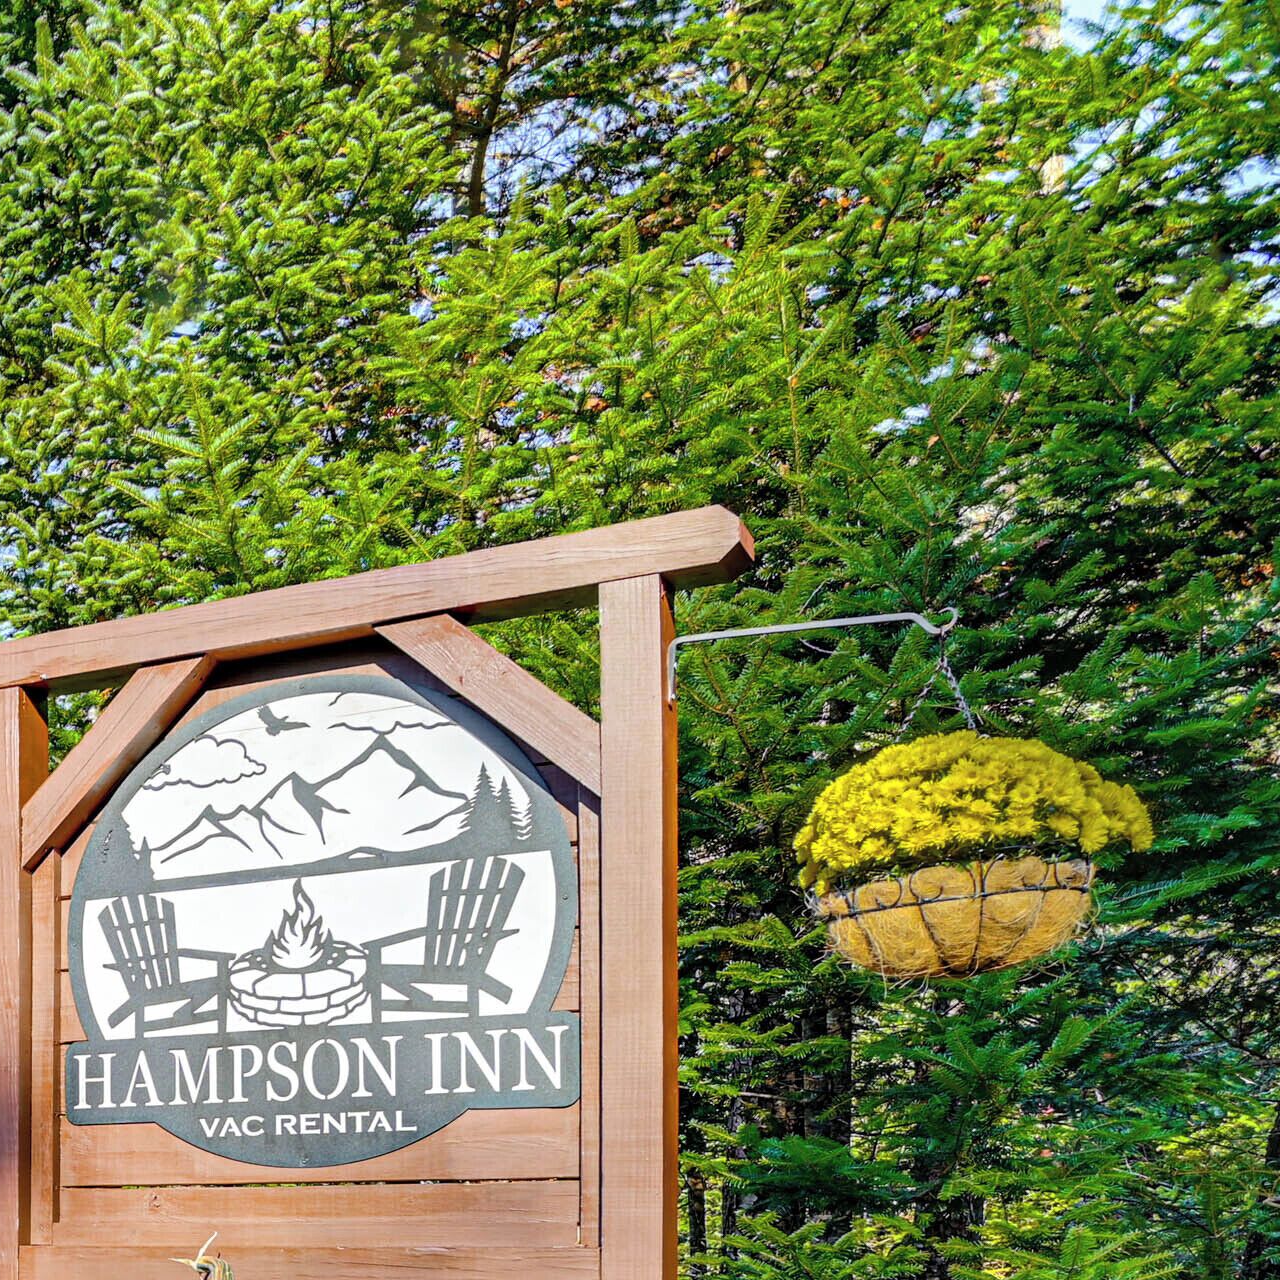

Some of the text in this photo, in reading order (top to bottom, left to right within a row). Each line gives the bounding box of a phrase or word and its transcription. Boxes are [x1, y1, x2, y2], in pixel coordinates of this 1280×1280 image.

[73, 1025, 570, 1110] HAMPSON INN
[199, 1110, 417, 1138] VAC RENTAL
